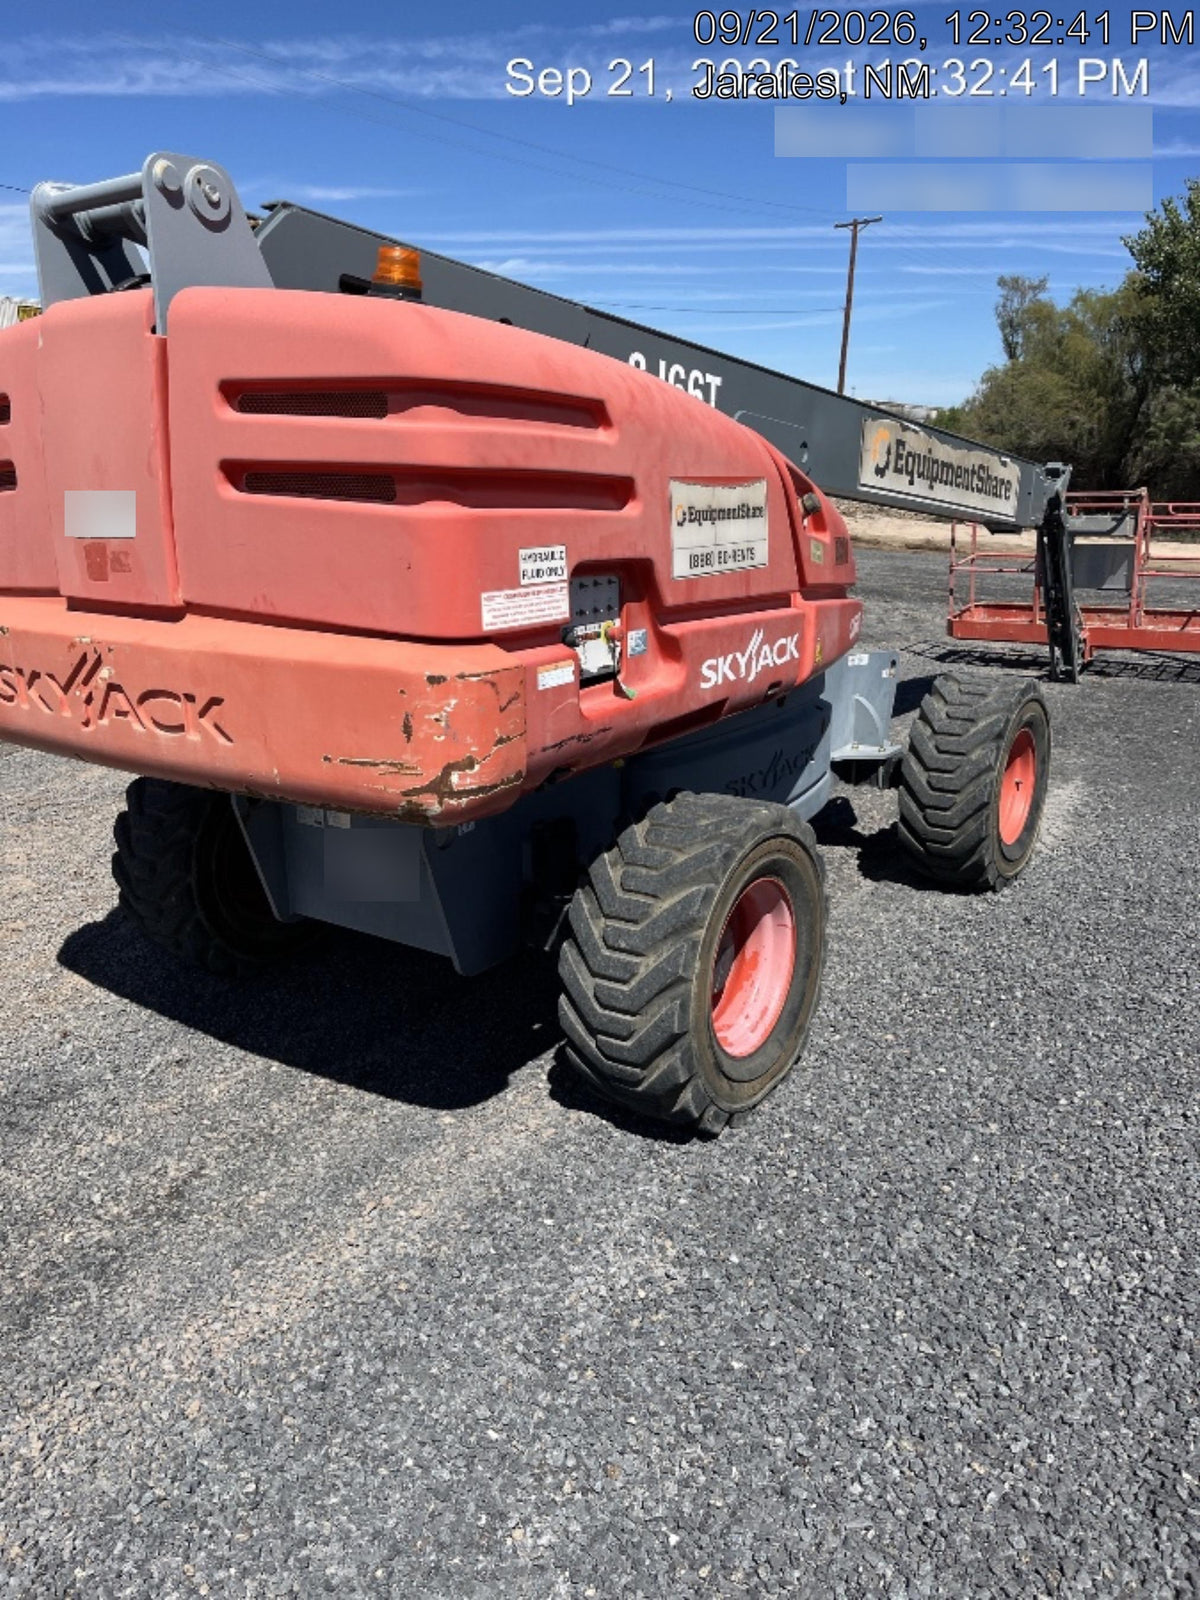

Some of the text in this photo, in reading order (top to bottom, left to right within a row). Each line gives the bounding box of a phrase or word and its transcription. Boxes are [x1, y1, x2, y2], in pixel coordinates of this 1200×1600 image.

[893, 438, 1013, 501] EquipmentShare
[688, 503, 764, 526] EquipmentShare
[701, 628, 799, 689] SKYJACK
[0, 651, 235, 744] SKYJACK
